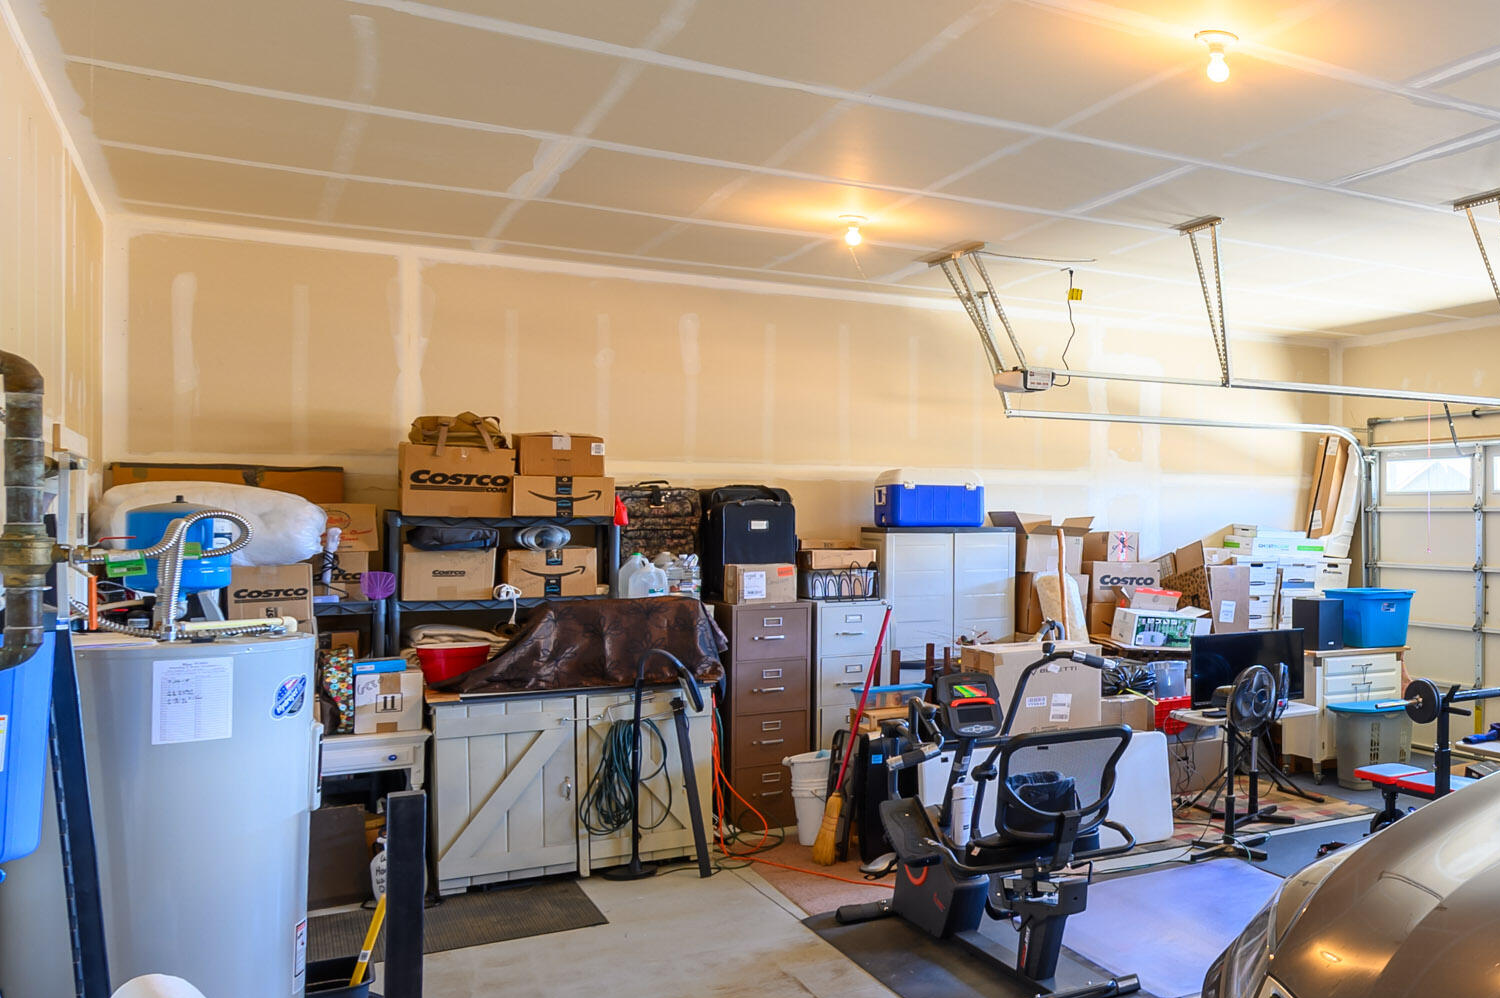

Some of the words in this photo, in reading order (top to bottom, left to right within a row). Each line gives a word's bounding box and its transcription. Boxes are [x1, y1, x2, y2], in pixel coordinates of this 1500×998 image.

[410, 469, 510, 486] COSTCO
[432, 569, 466, 577] COSTCO
[1100, 574, 1155, 586] COSTCO
[233, 588, 308, 599] COSTCO
